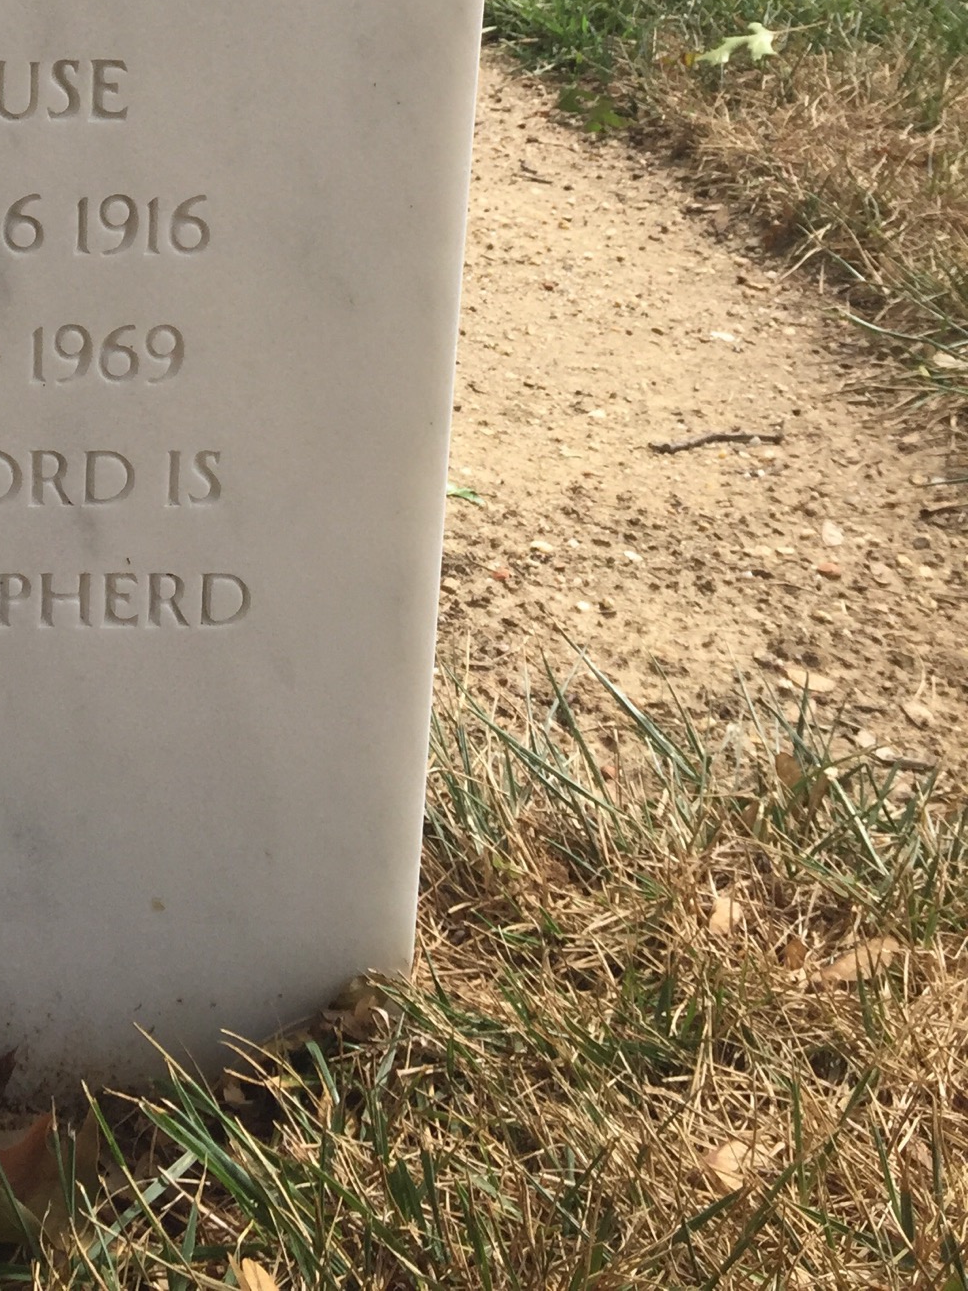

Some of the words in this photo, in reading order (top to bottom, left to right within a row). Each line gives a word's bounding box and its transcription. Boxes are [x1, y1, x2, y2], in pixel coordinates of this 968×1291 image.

[76, 192, 211, 256] 1916
[32, 322, 186, 385] 1969
[165, 450, 224, 508] IS
